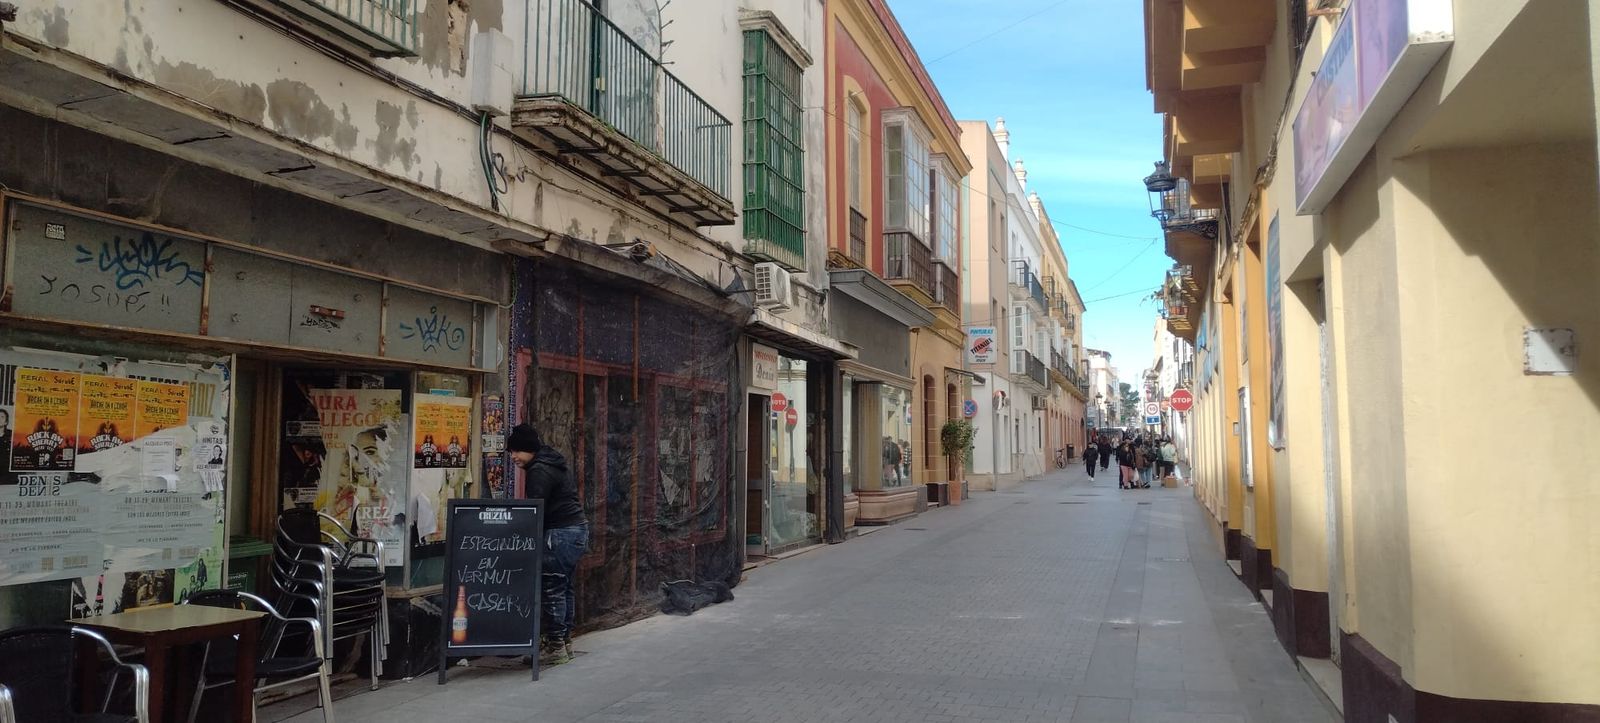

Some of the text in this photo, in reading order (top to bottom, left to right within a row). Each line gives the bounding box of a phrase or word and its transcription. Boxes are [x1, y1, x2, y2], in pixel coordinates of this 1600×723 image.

[27, 431, 49, 444] ROCK
[479, 511, 513, 520] CRUZIAL
[478, 556, 499, 570] EN
[458, 565, 523, 585] VERMUT
